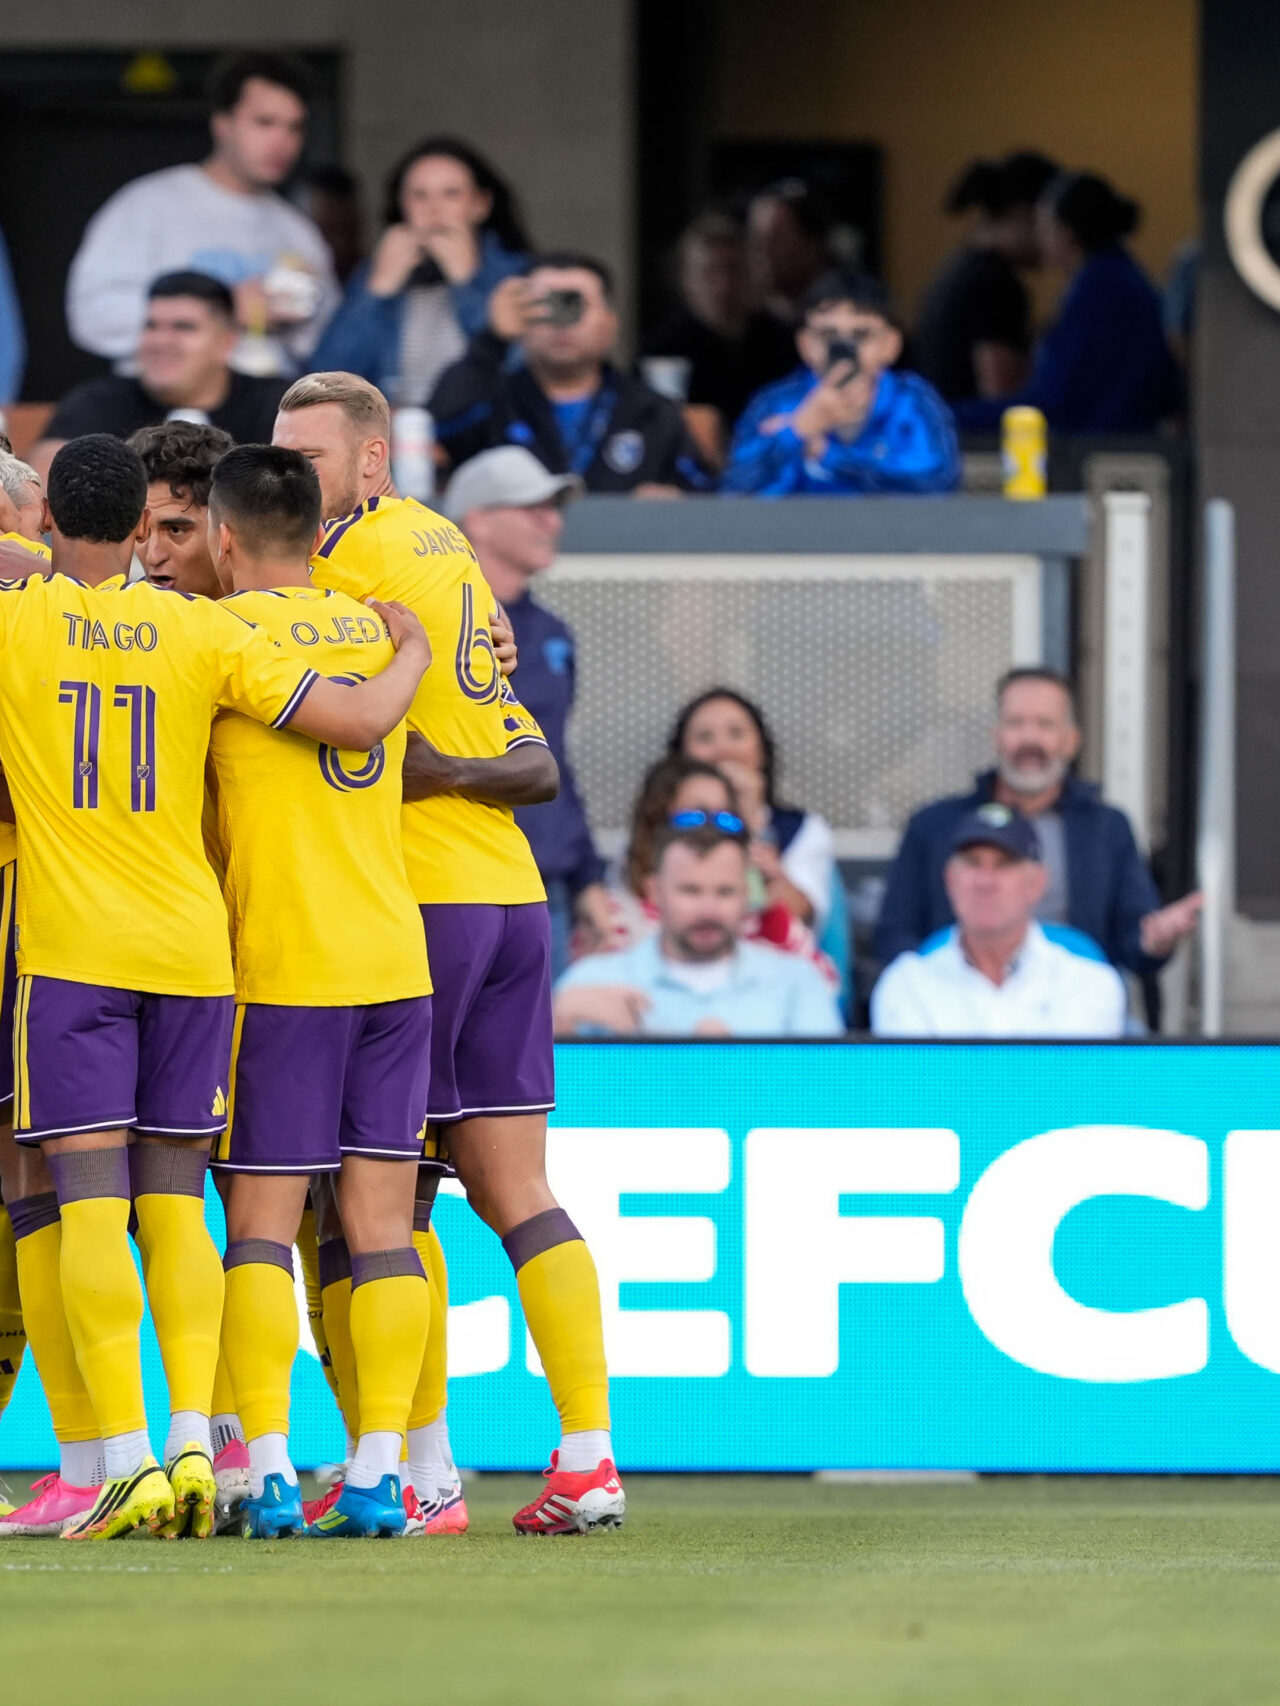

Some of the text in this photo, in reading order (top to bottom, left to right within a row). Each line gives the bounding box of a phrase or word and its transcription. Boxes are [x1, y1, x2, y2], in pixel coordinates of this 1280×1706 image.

[62, 611, 158, 652] TIAGO
[291, 617, 391, 646] OJED
[455, 582, 499, 705] 6
[517, 715, 537, 731] tv
[58, 680, 156, 812] 11
